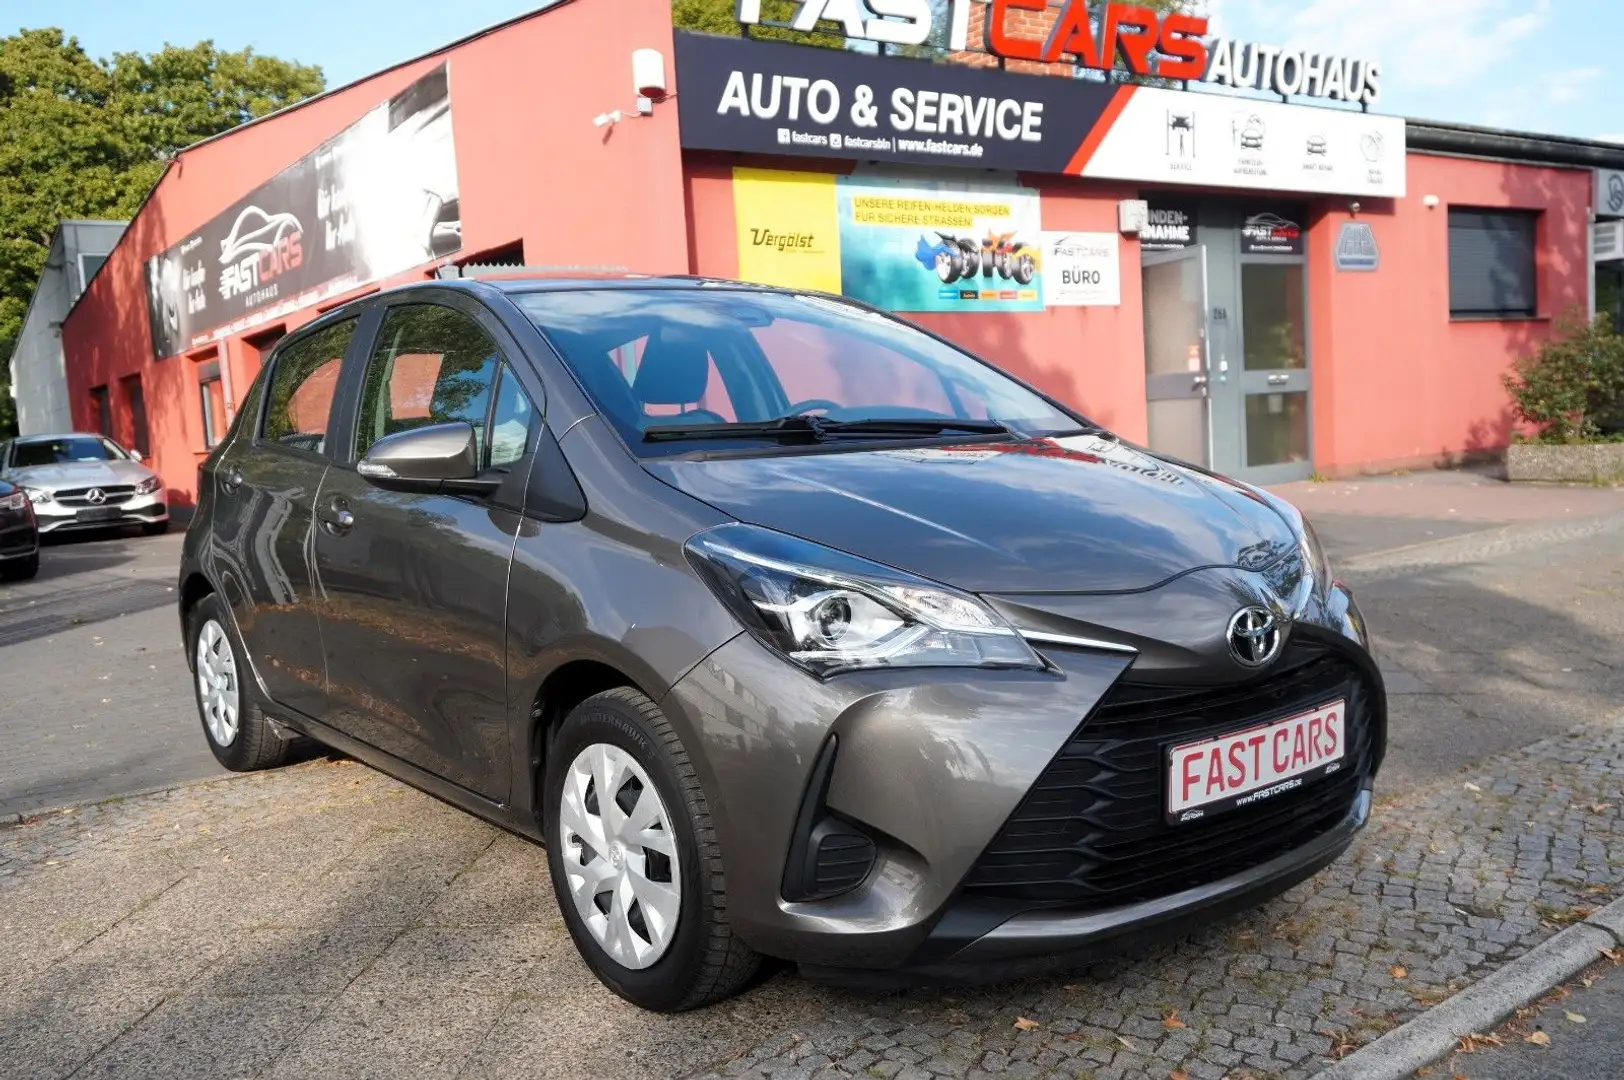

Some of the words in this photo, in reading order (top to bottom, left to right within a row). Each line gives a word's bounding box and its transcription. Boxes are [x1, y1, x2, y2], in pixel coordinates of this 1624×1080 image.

[1206, 36, 1381, 104] AUTOHAUS
[717, 70, 841, 124] AUTO
[850, 84, 879, 128] &
[889, 87, 1044, 142] SERVICE
[791, 130, 829, 146] fastcars
[897, 138, 984, 158] www.fastcars.de
[854, 197, 895, 210] UNSERE
[877, 212, 921, 225] SICHERE
[750, 227, 815, 252] Vergölst
[1062, 265, 1101, 285] BÜRO
[1182, 734, 1266, 802] FAST
[1272, 711, 1338, 774] CARS
